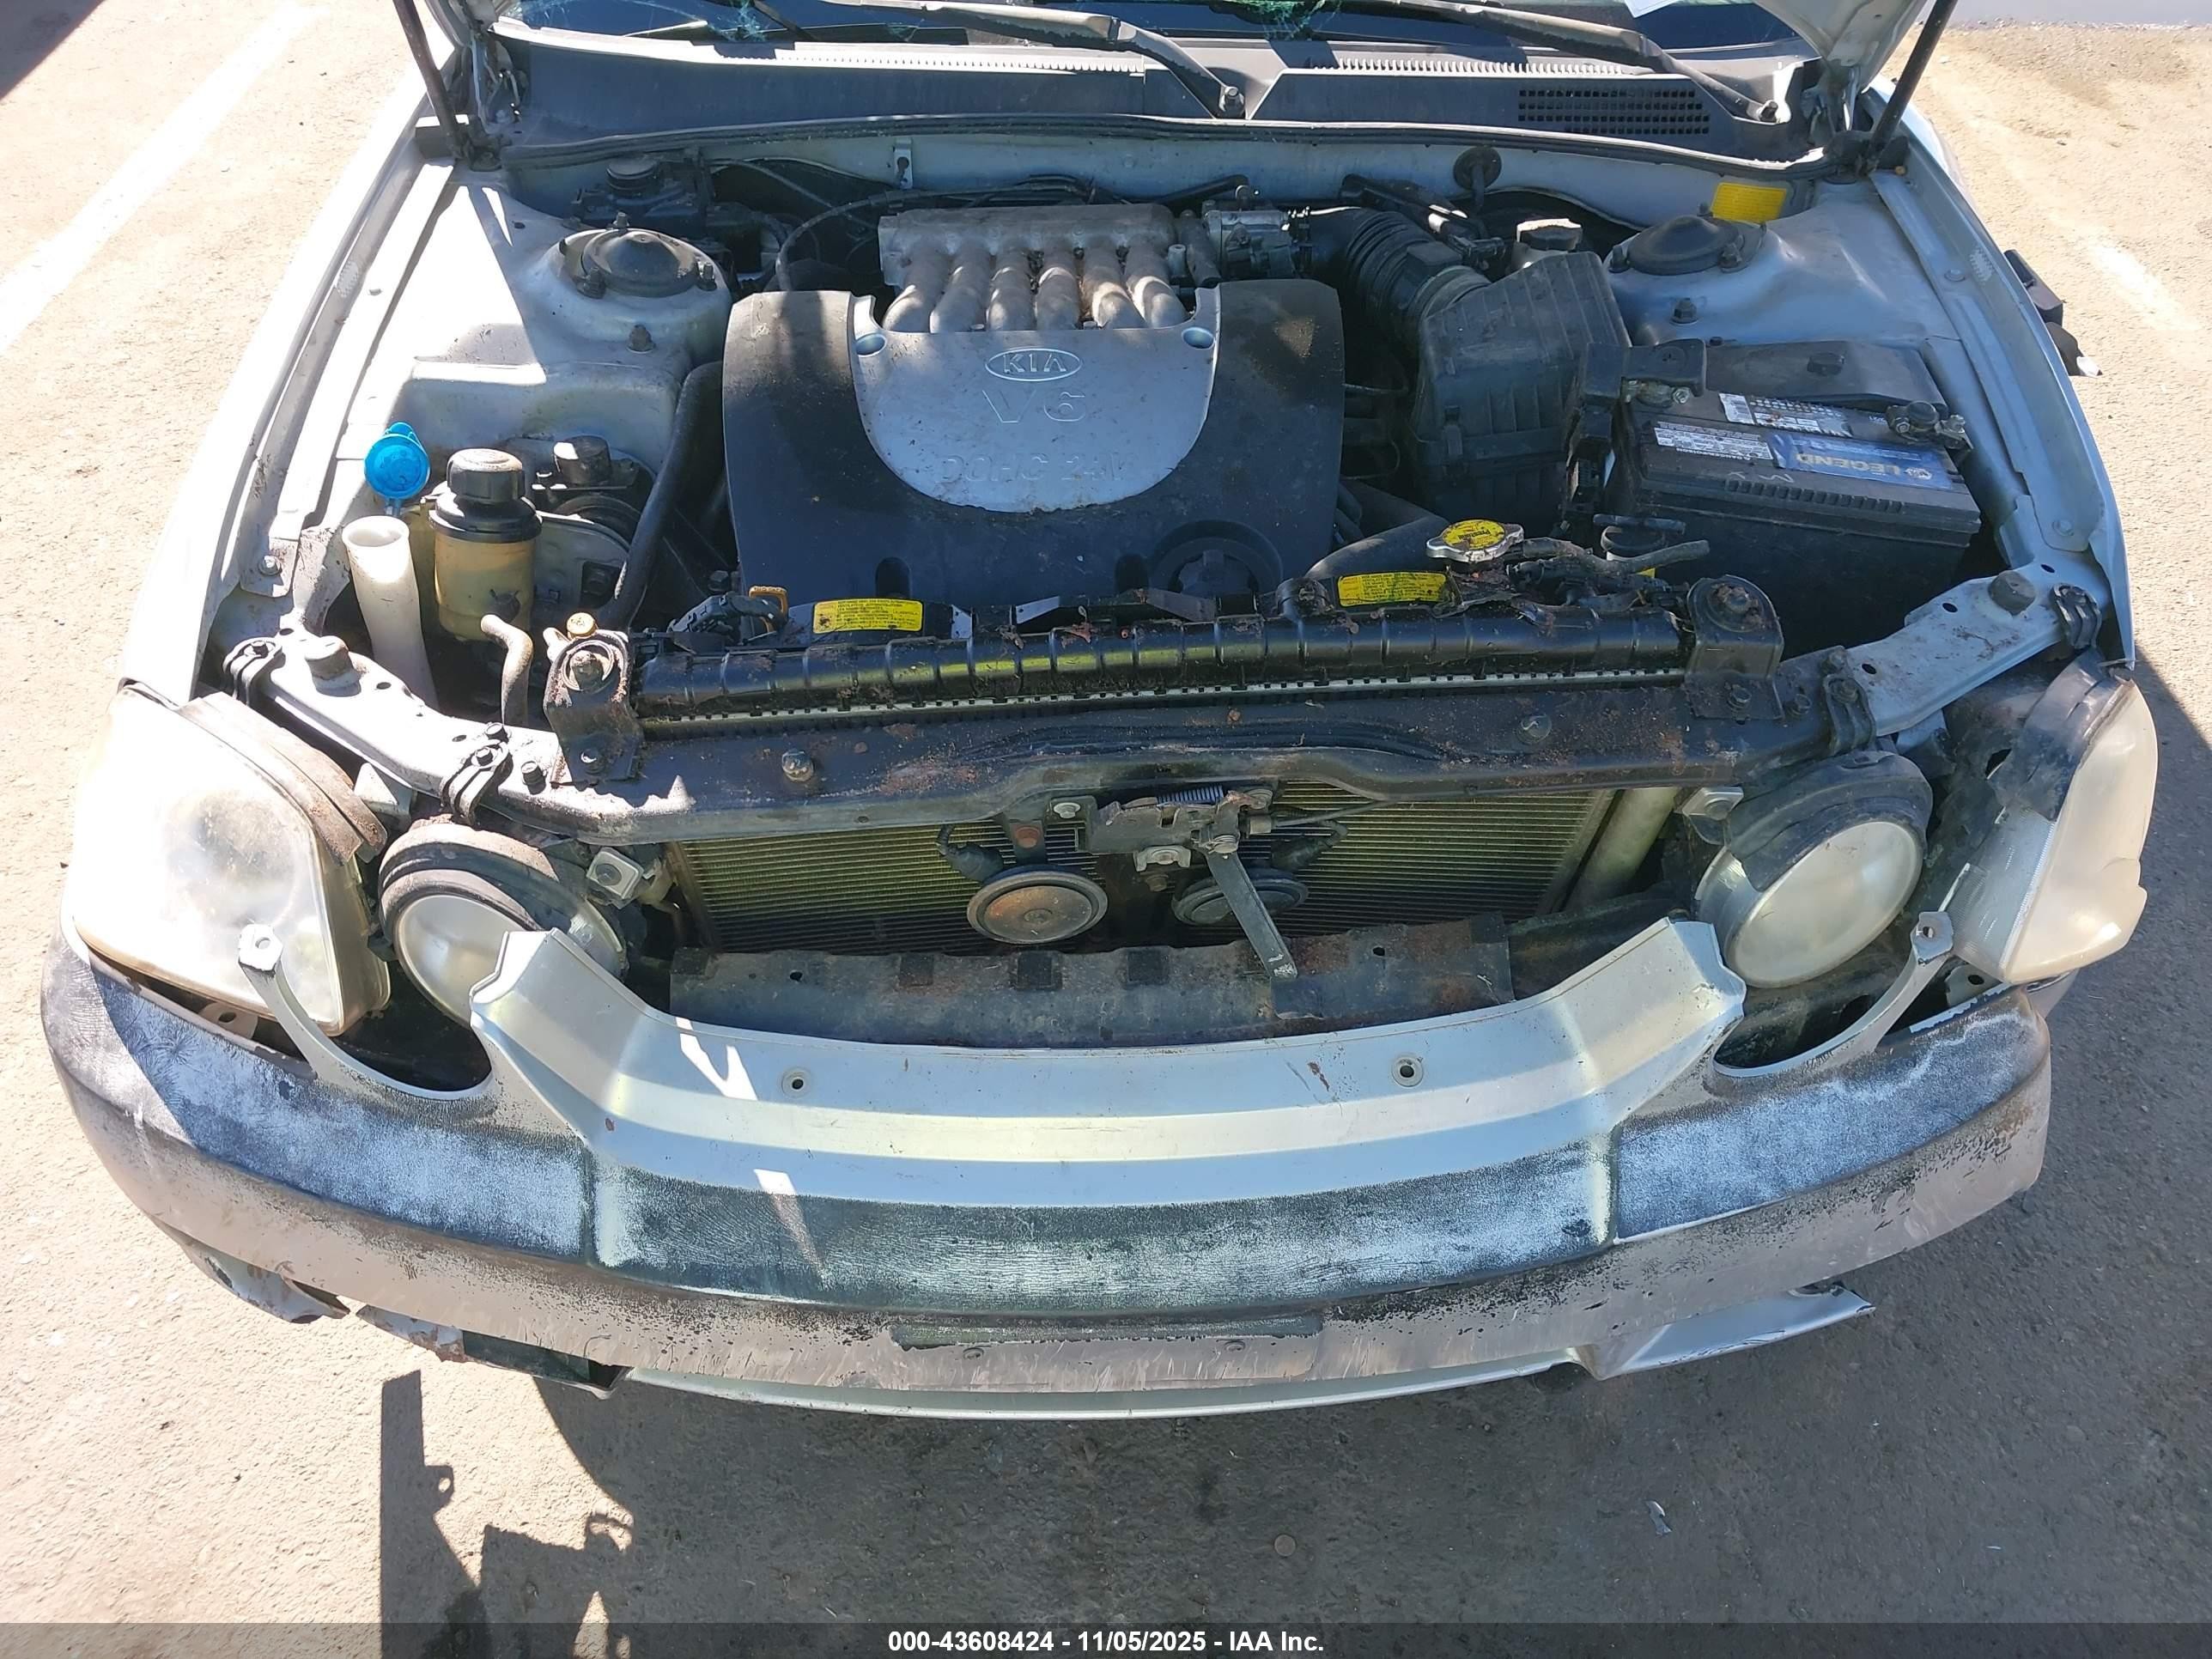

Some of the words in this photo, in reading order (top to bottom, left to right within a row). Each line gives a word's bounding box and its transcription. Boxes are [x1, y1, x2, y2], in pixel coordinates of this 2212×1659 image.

[1002, 353, 1066, 373] KIA
[981, 389, 1086, 422] V6
[934, 453, 1048, 483] DOHC
[1796, 453, 1900, 476] LEGEND
